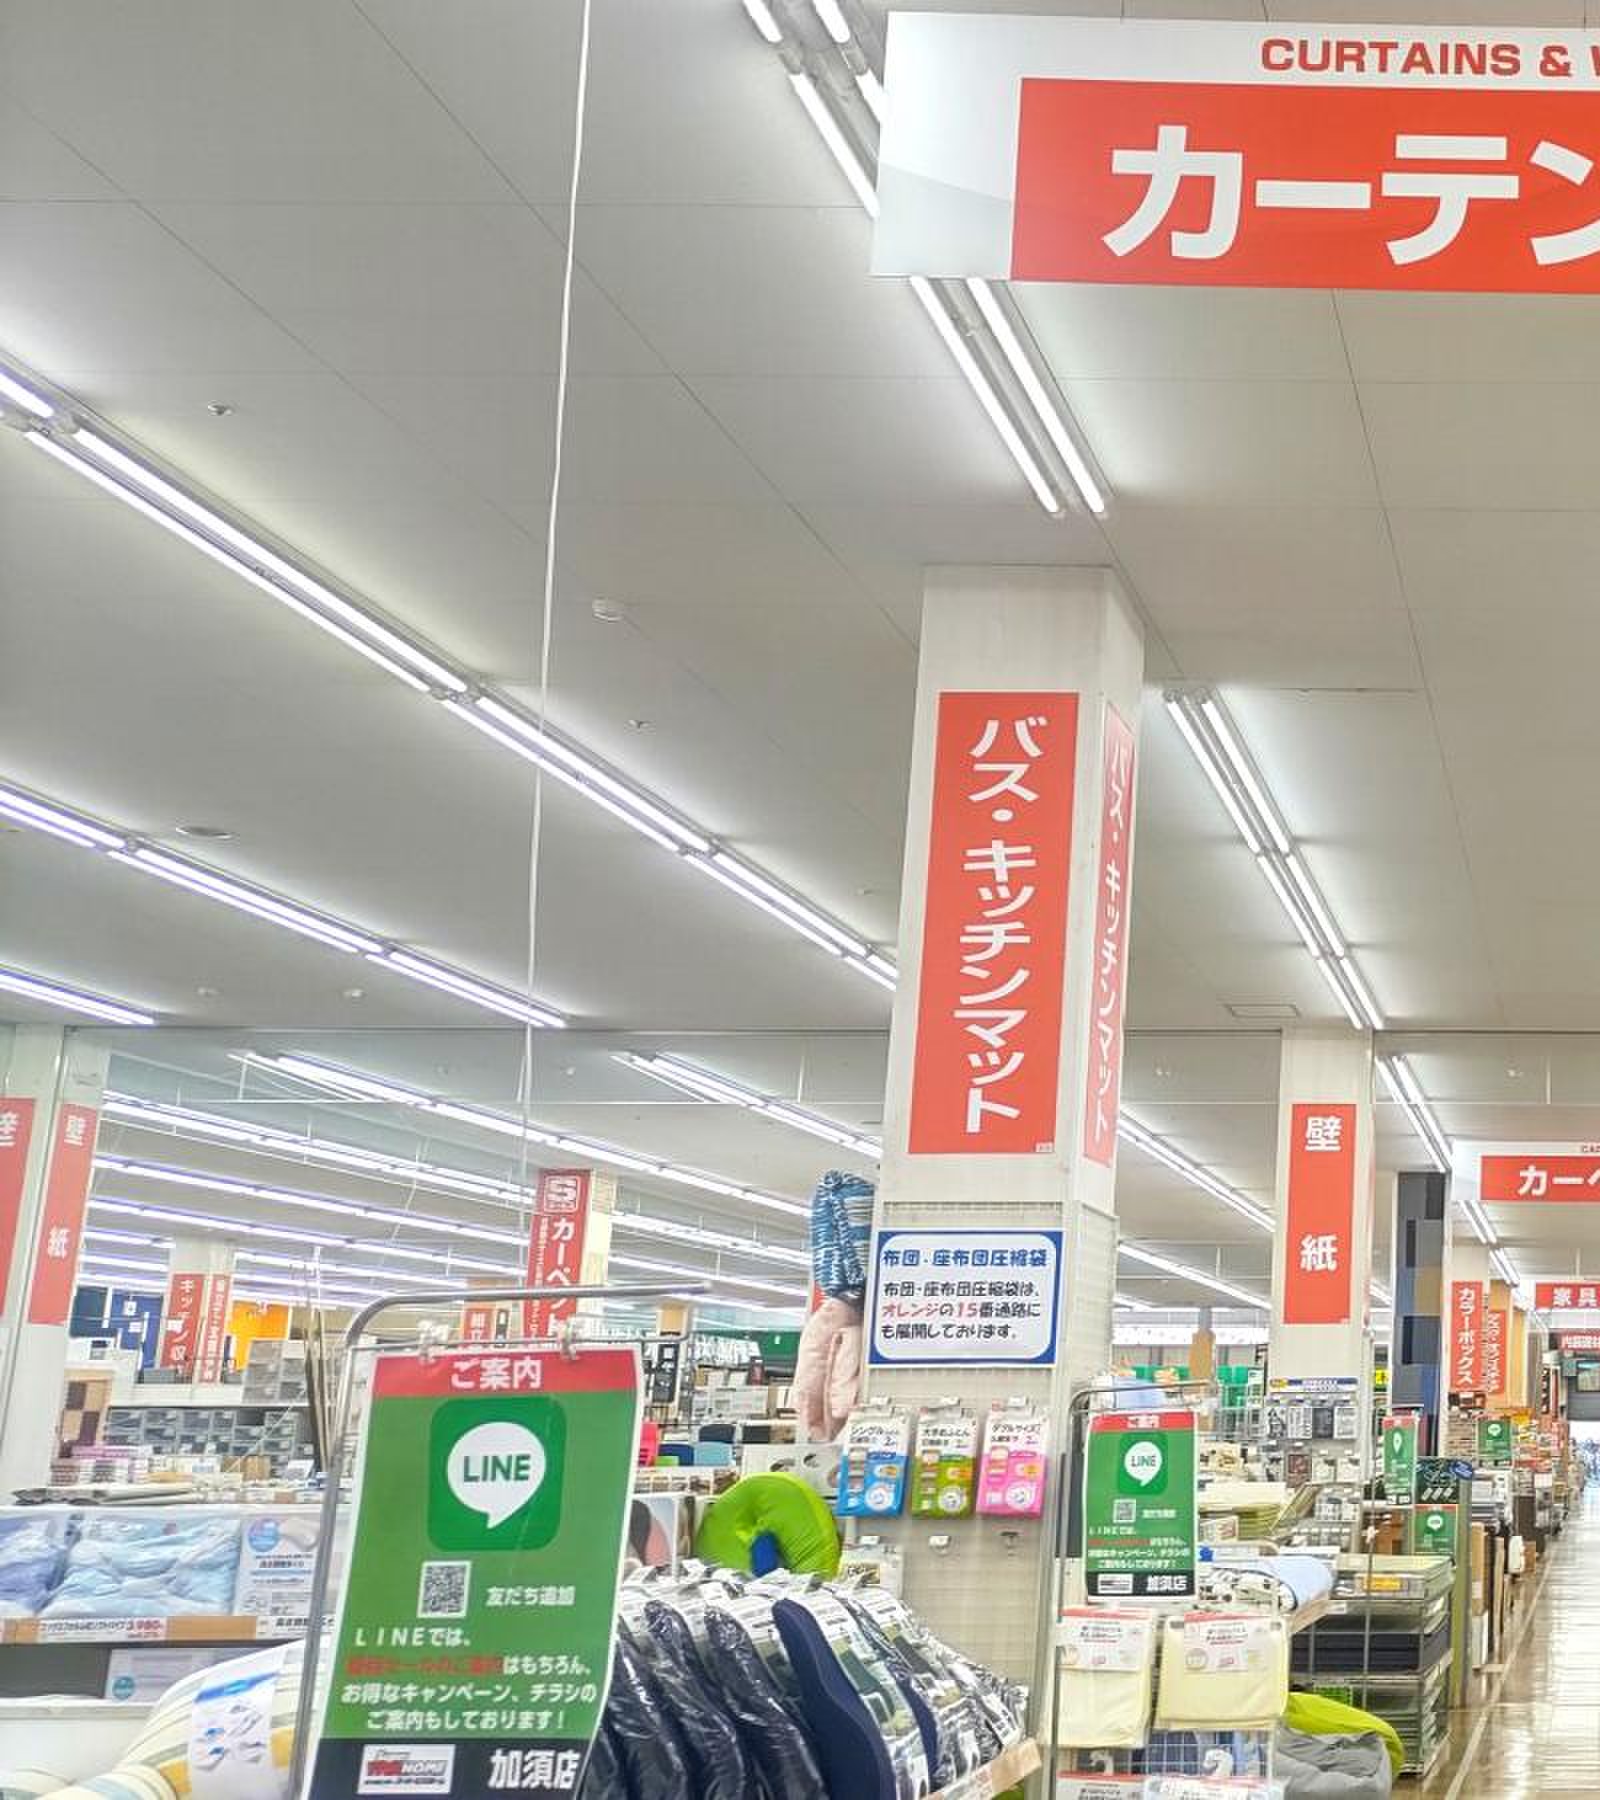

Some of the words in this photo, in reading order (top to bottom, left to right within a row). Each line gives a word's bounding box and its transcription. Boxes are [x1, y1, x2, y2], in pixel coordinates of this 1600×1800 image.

[1260, 38, 1528, 78] CURTAINS
[1539, 40, 1576, 78] &
[953, 715, 1048, 1134] バス・キッチンマット
[1299, 1115, 1342, 1272] 壁紙
[882, 1248, 1048, 1268] 布団・座布団圧縮袋
[881, 1301, 1041, 1319] オレンジの15番通路に
[880, 1323, 1018, 1340] も展開しております。
[1457, 1286, 1476, 1385] カラーボックス
[449, 1356, 542, 1390] ご案内
[463, 1453, 532, 1484] LINE
[1131, 1453, 1158, 1469] LINE
[485, 1585, 577, 1607] 友だち追加
[354, 1627, 471, 1648] LINEでは、
[487, 1748, 582, 1790] 加須店
